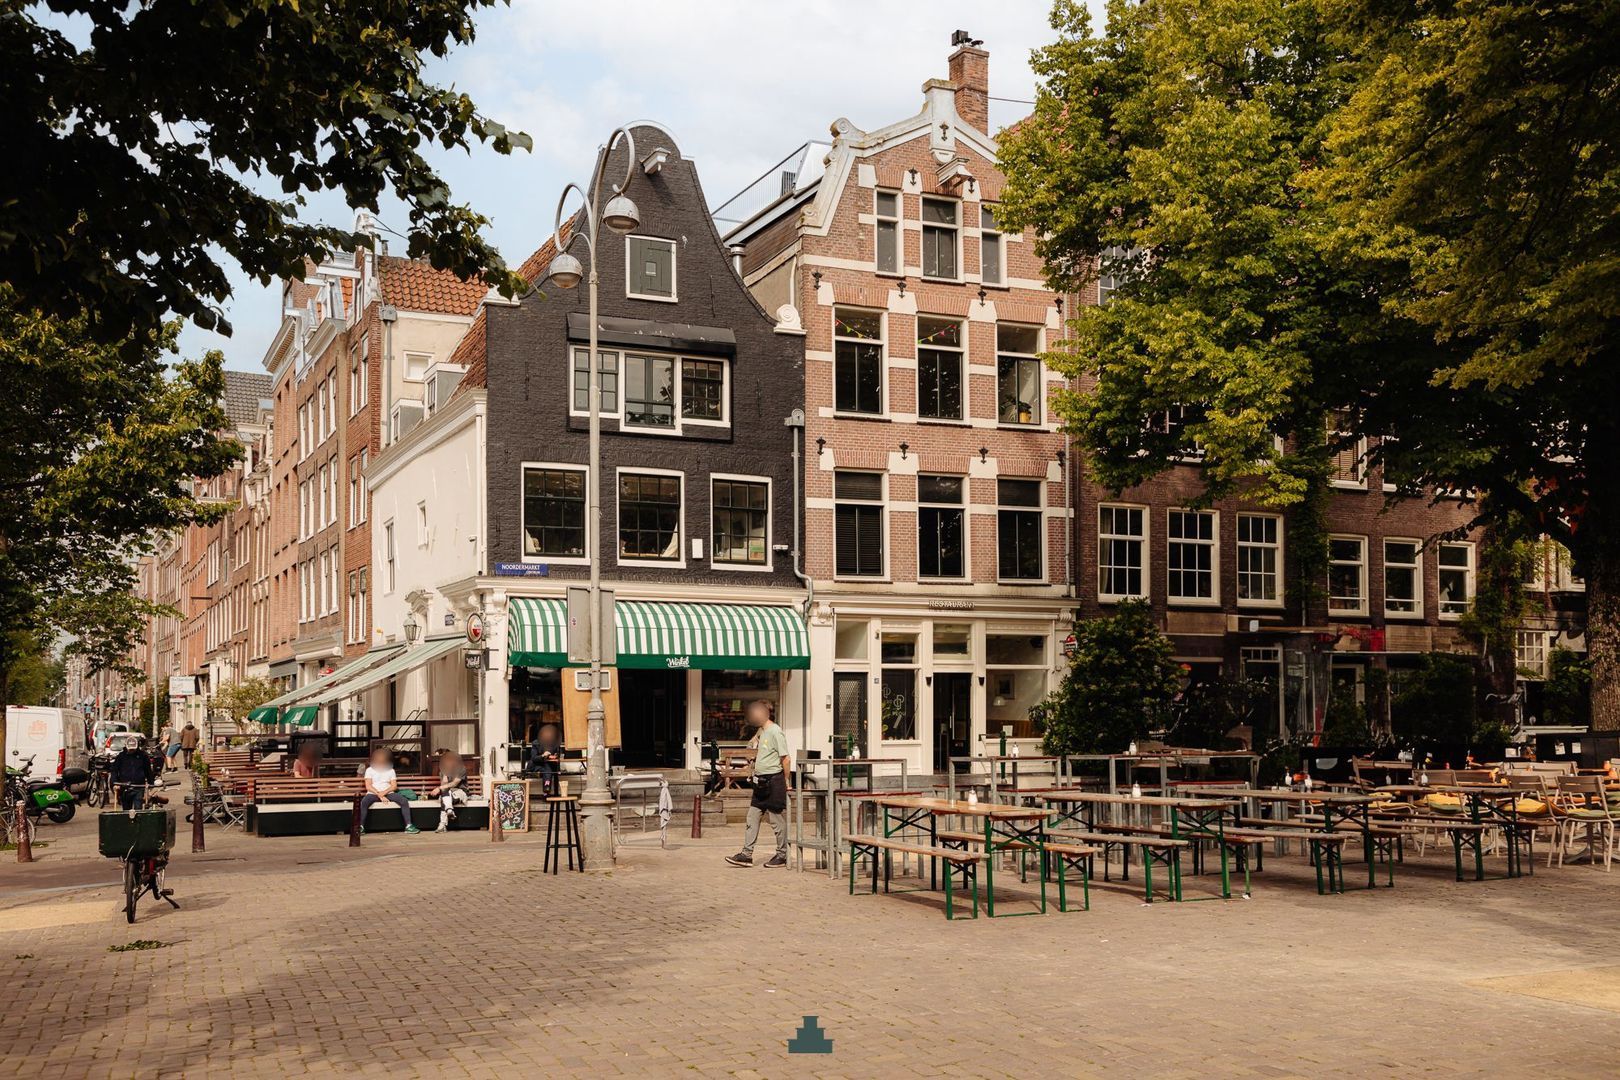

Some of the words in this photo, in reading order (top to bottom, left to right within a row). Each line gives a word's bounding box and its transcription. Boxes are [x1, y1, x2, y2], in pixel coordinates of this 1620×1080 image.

[929, 600, 975, 608] RESTAURANT
[666, 656, 690, 668] Winkel
[46, 793, 59, 801] GO
